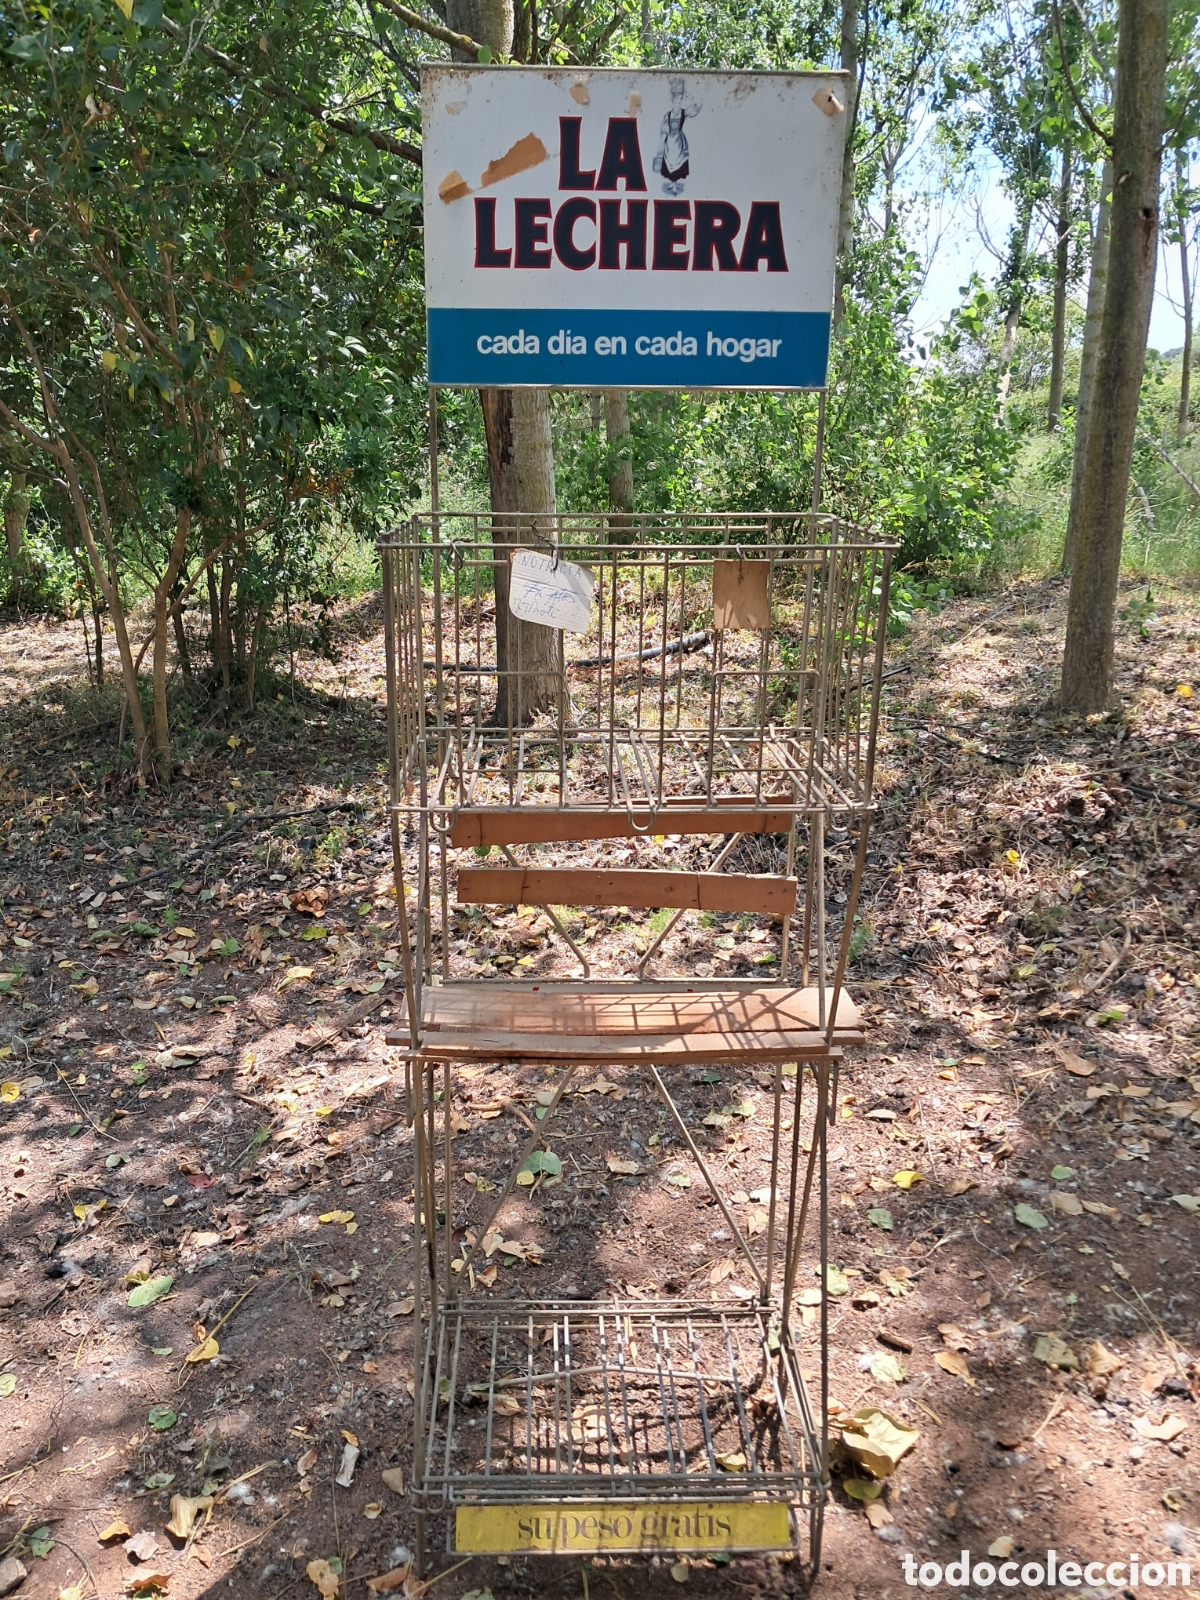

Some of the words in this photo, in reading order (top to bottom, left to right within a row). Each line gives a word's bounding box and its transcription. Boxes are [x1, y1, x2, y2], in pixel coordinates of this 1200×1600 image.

[558, 116, 648, 192] LA
[474, 196, 790, 273] LECHERA
[476, 329, 540, 355] cada
[594, 335, 627, 355] en
[634, 331, 697, 356] cada
[706, 331, 783, 363] hogar
[518, 1514, 551, 1541] su
[558, 1514, 633, 1548] peso
[641, 1504, 732, 1547] gratis
